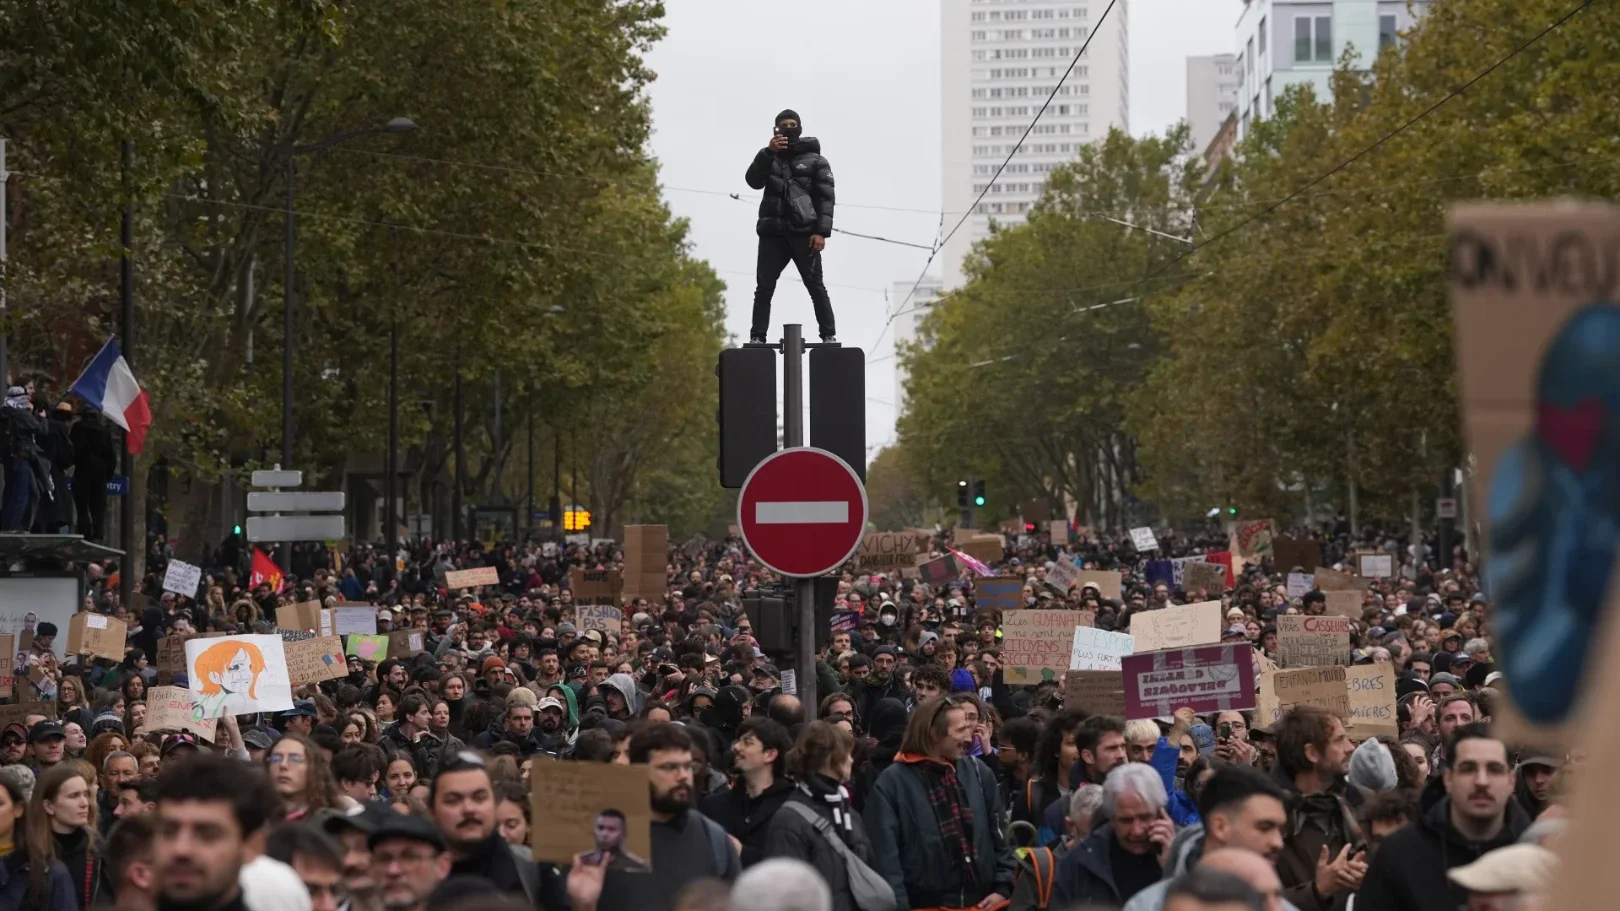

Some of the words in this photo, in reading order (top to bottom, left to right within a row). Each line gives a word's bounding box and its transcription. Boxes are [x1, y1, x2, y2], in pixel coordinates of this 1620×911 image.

[862, 535, 914, 553] VICHY
[584, 617, 606, 629] PAS
[1278, 622, 1300, 632] VRAIS
[1303, 616, 1350, 633] CASSEURS
[1003, 638, 1059, 653] CITOYENS
[1003, 653, 1050, 666] SECONDE
[1073, 648, 1094, 660] PLUS
[1279, 670, 1317, 689] ENFANTS
